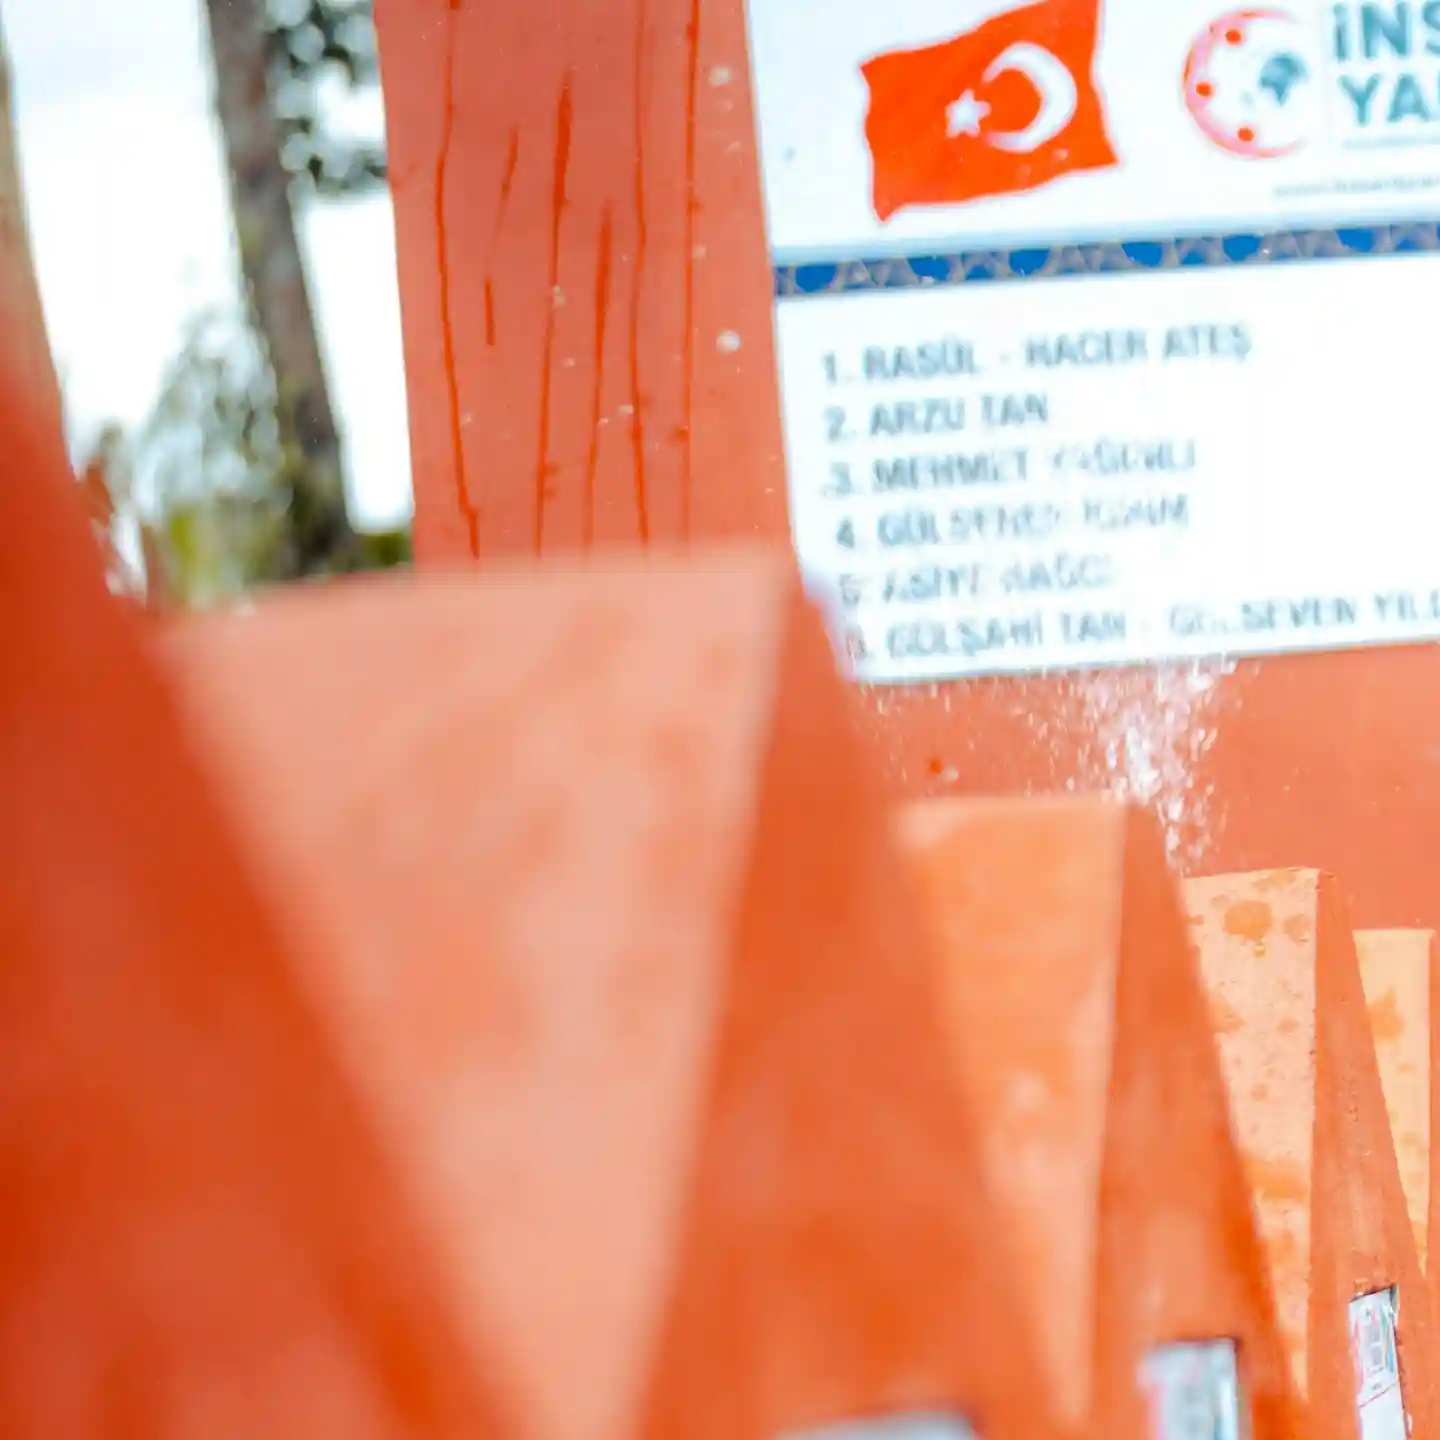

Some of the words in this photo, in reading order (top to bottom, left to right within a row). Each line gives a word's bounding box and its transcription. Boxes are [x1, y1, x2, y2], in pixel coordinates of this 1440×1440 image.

[862, 336, 979, 382] RASÜL
[1161, 322, 1254, 362] ATEŞ
[869, 397, 966, 437] ARZU
[979, 392, 1050, 426] TAN
